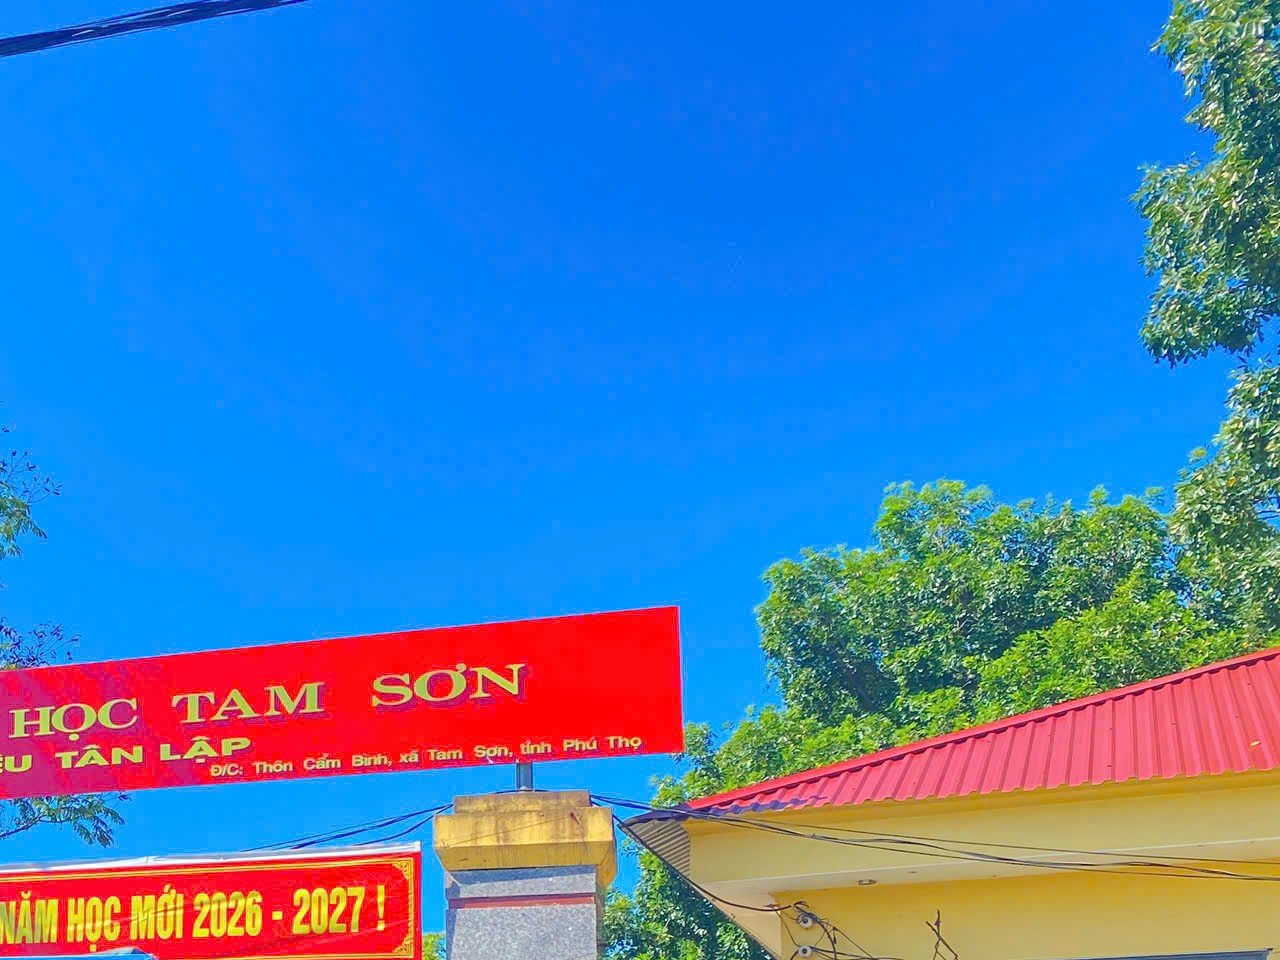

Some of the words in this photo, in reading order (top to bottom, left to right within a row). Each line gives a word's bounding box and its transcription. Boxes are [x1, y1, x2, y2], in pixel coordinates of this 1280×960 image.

[9, 697, 139, 741] HỌC
[172, 681, 325, 724] TAM
[372, 663, 526, 707] SƠN
[56, 745, 143, 769] TÂN
[160, 736, 251, 764] LẬP
[253, 761, 293, 774] Thôn
[400, 750, 418, 763] xã
[427, 748, 463, 761] Tam
[473, 744, 513, 758] Sơn,
[563, 738, 597, 751] Phú
[607, 735, 642, 750] Thọ
[67, 895, 120, 951] HỌC
[131, 884, 183, 940] MỚI
[193, 891, 262, 938] 2026
[272, 912, 282, 920] -
[292, 887, 365, 935] 2027
[377, 885, 385, 931] !
